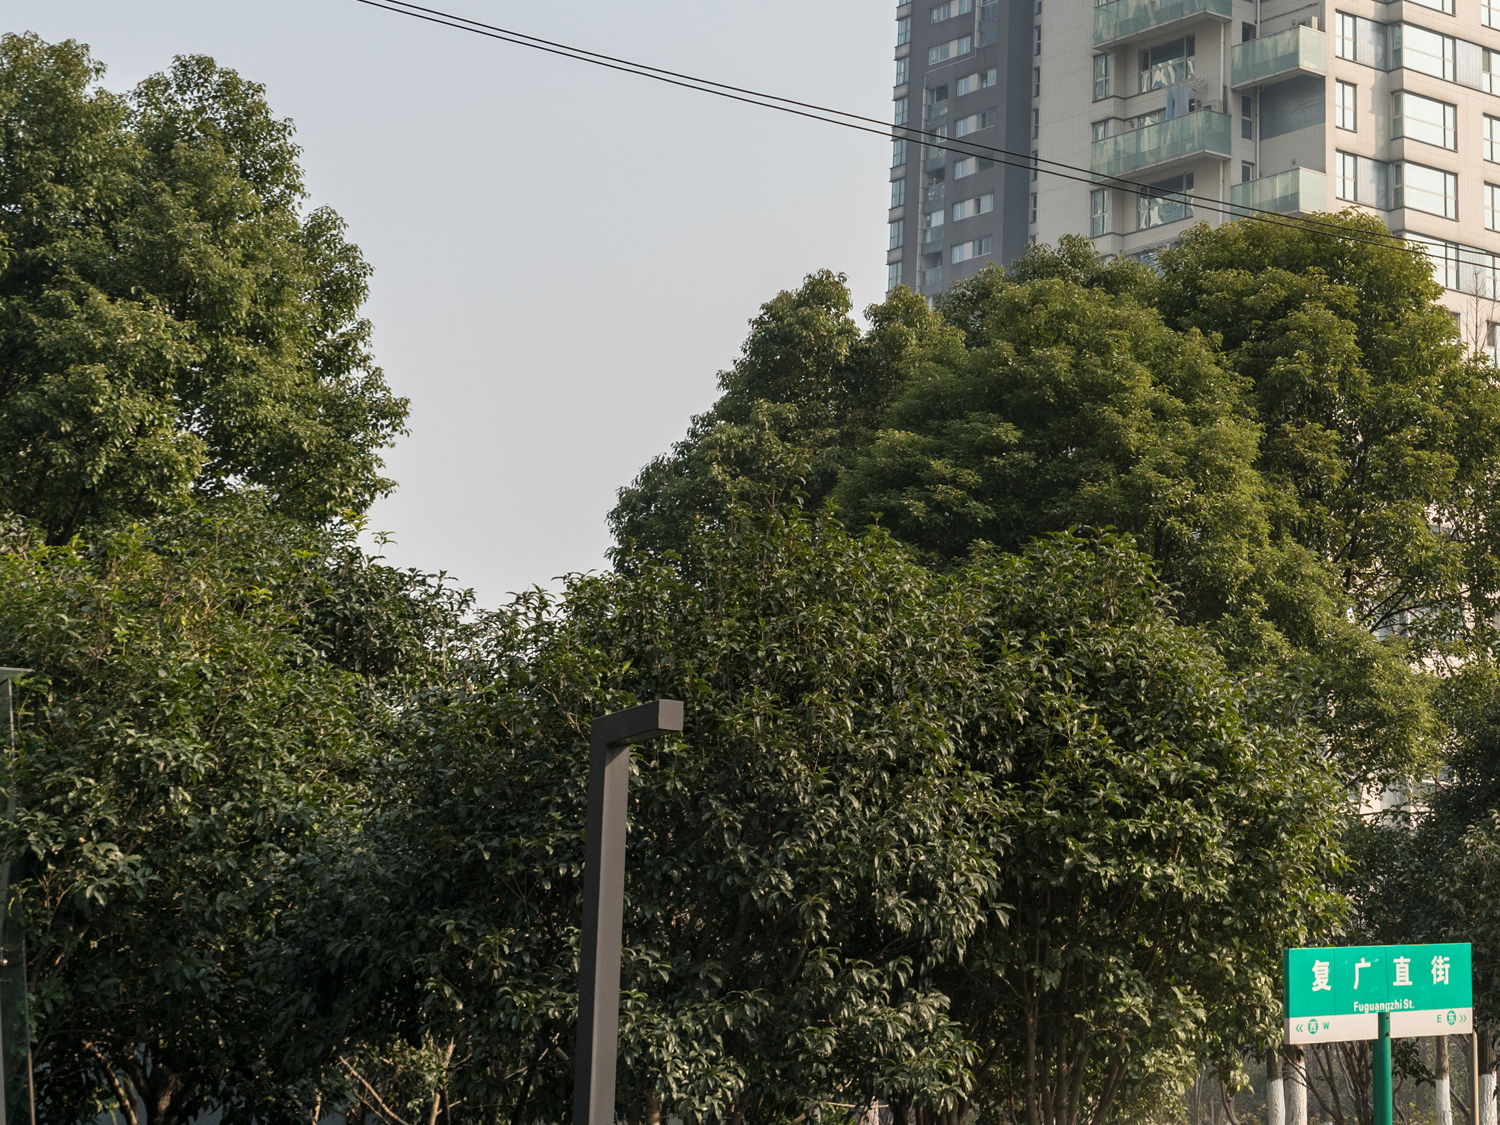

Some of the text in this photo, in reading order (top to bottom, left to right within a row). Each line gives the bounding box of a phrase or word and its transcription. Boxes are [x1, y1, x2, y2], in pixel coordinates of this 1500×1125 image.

[1311, 955, 1451, 992] 复广直街
[1353, 998, 1415, 1014] Fuguangzhi St.
[1436, 1014, 1442, 1023] E
[1447, 1011, 1456, 1024] 东
[1309, 1021, 1317, 1032] 西
[1322, 1021, 1330, 1030] W
